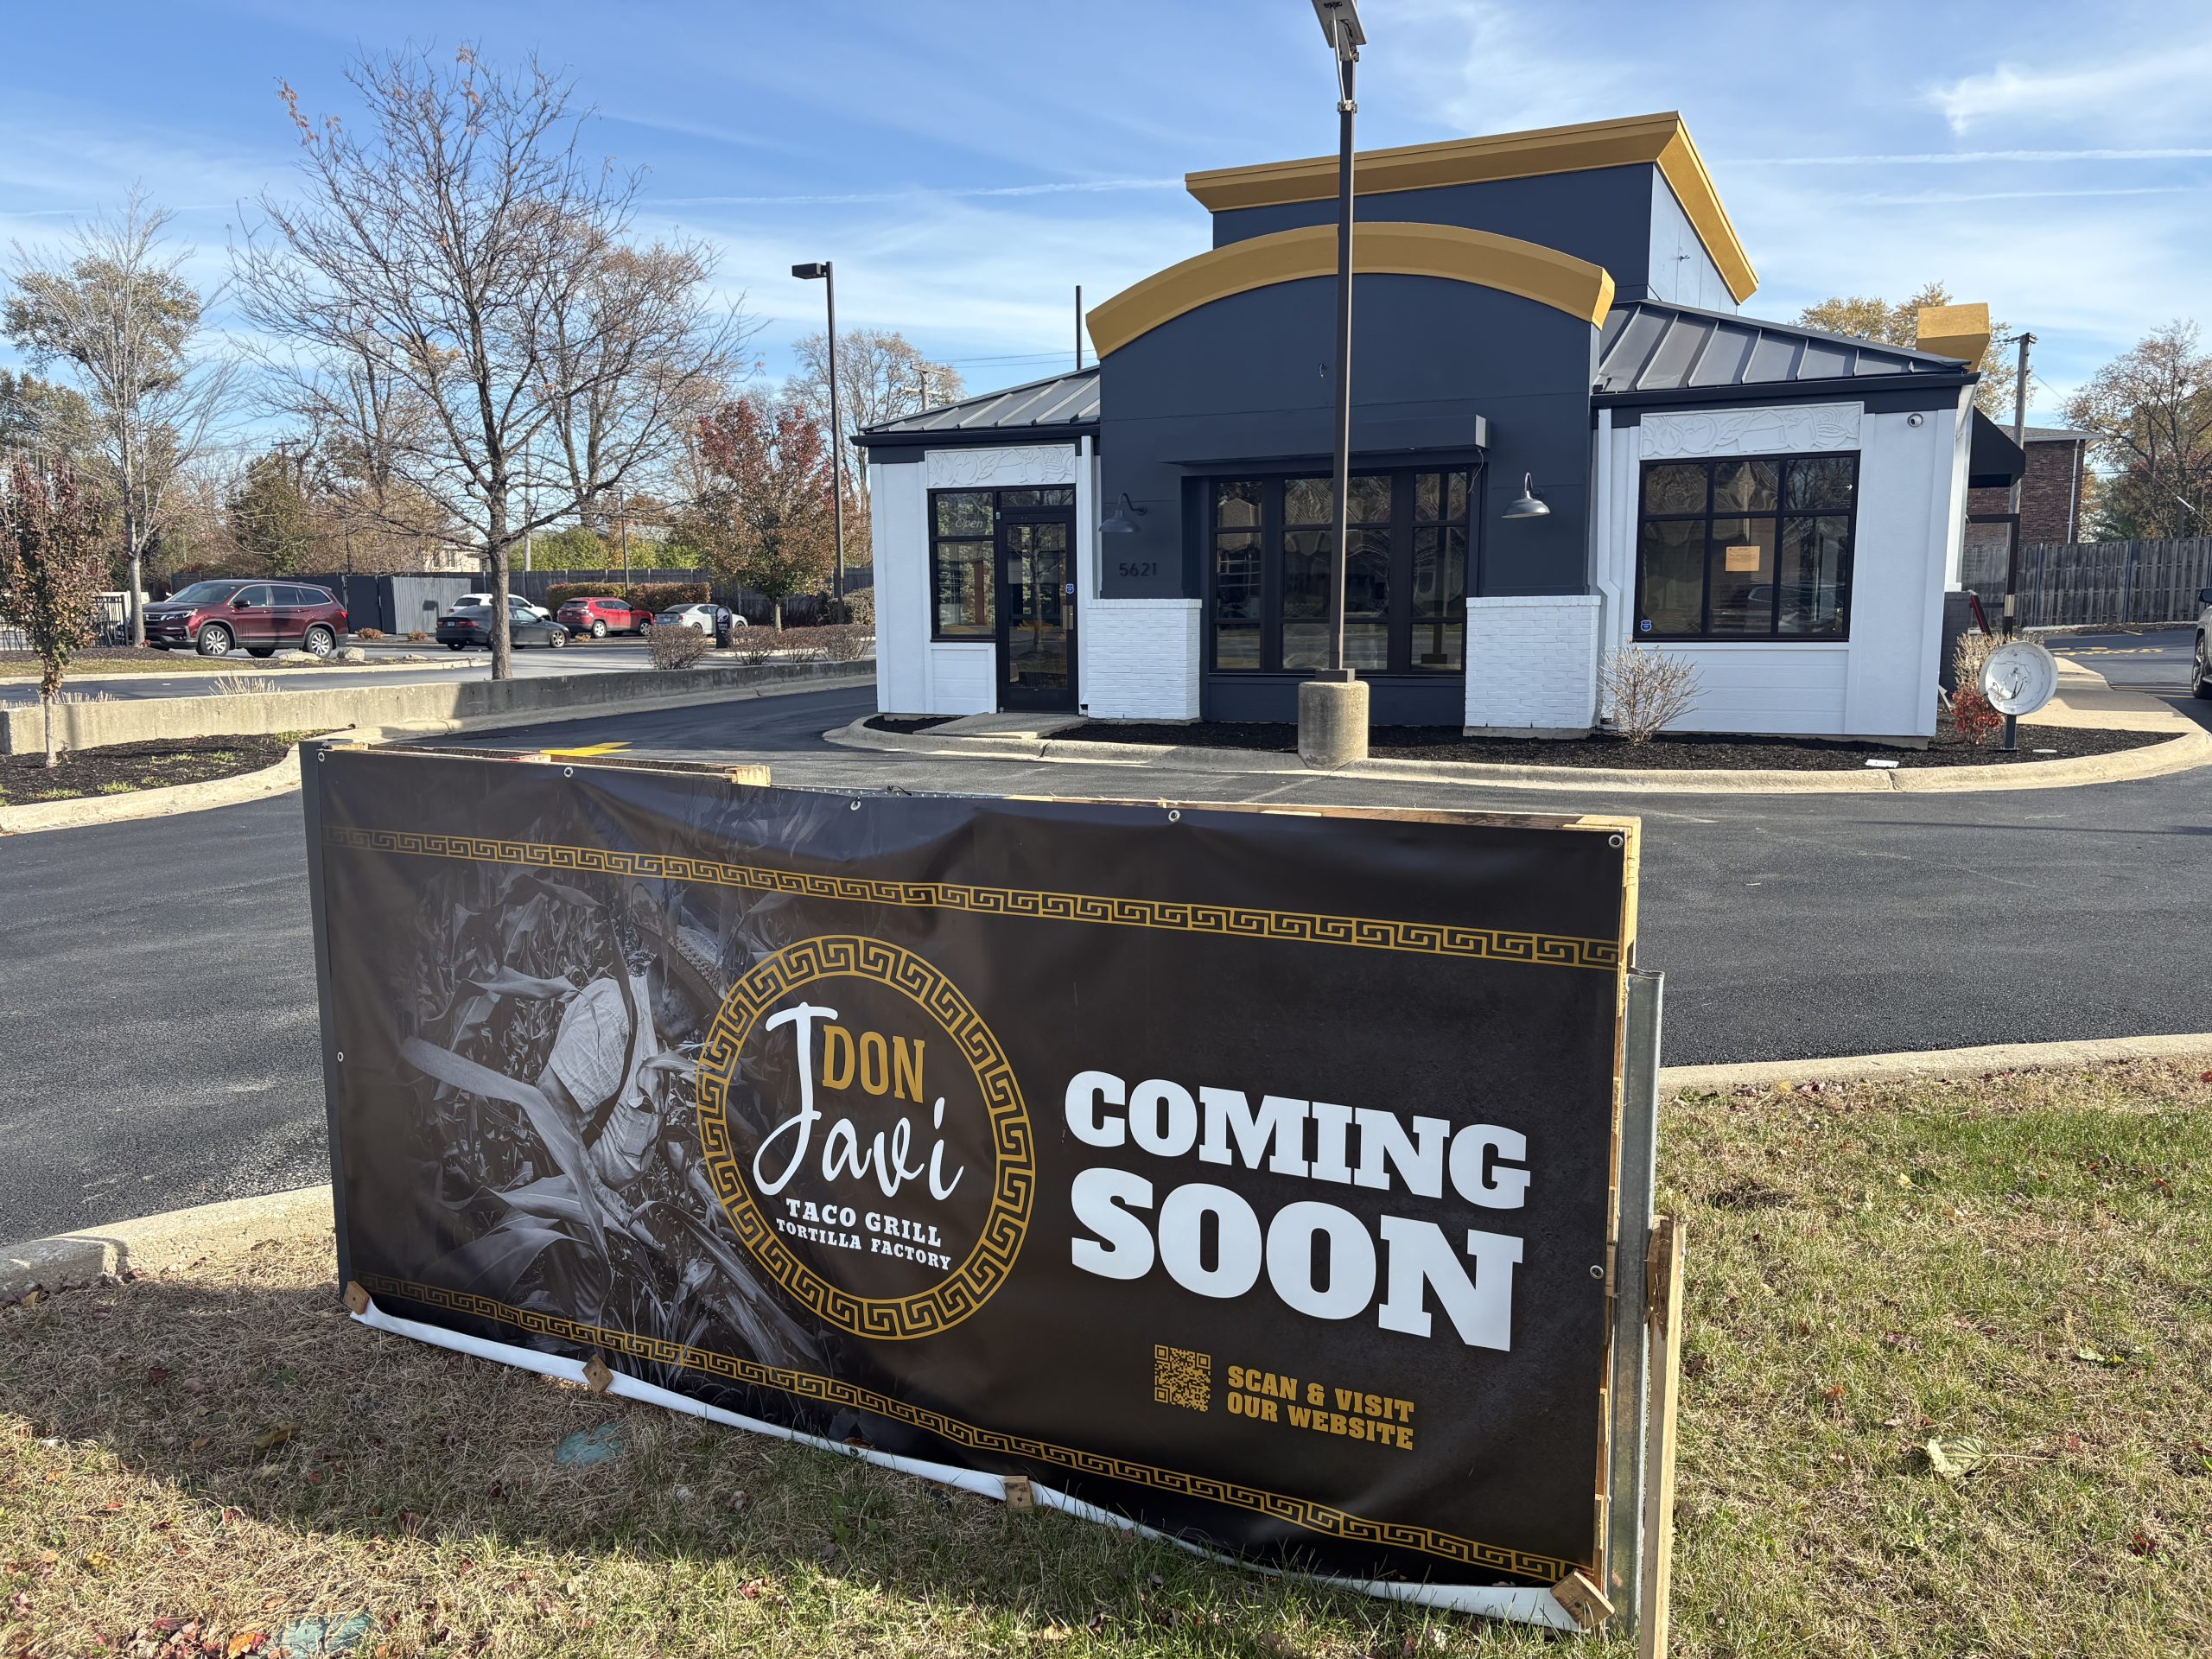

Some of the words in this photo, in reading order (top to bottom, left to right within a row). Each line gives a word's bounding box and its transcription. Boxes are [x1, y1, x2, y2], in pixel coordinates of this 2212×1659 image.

[955, 518, 983, 530] Open
[1119, 563, 1158, 576] 5621
[822, 1025, 925, 1103] DON
[753, 1001, 964, 1201] Javi
[1065, 1071, 1531, 1210] COMING
[776, 1217, 862, 1250] TORTILLA
[870, 1237, 951, 1271] FACTORY
[786, 1198, 856, 1228] TACO
[865, 1211, 941, 1248] GRILL
[1071, 1167, 1524, 1352] SOON
[1227, 1365, 1298, 1402] SCAN
[1306, 1382, 1325, 1407] &
[1334, 1388, 1414, 1423] VISIT
[1227, 1391, 1279, 1422] OUR
[1287, 1405, 1414, 1450] WEBSITE
